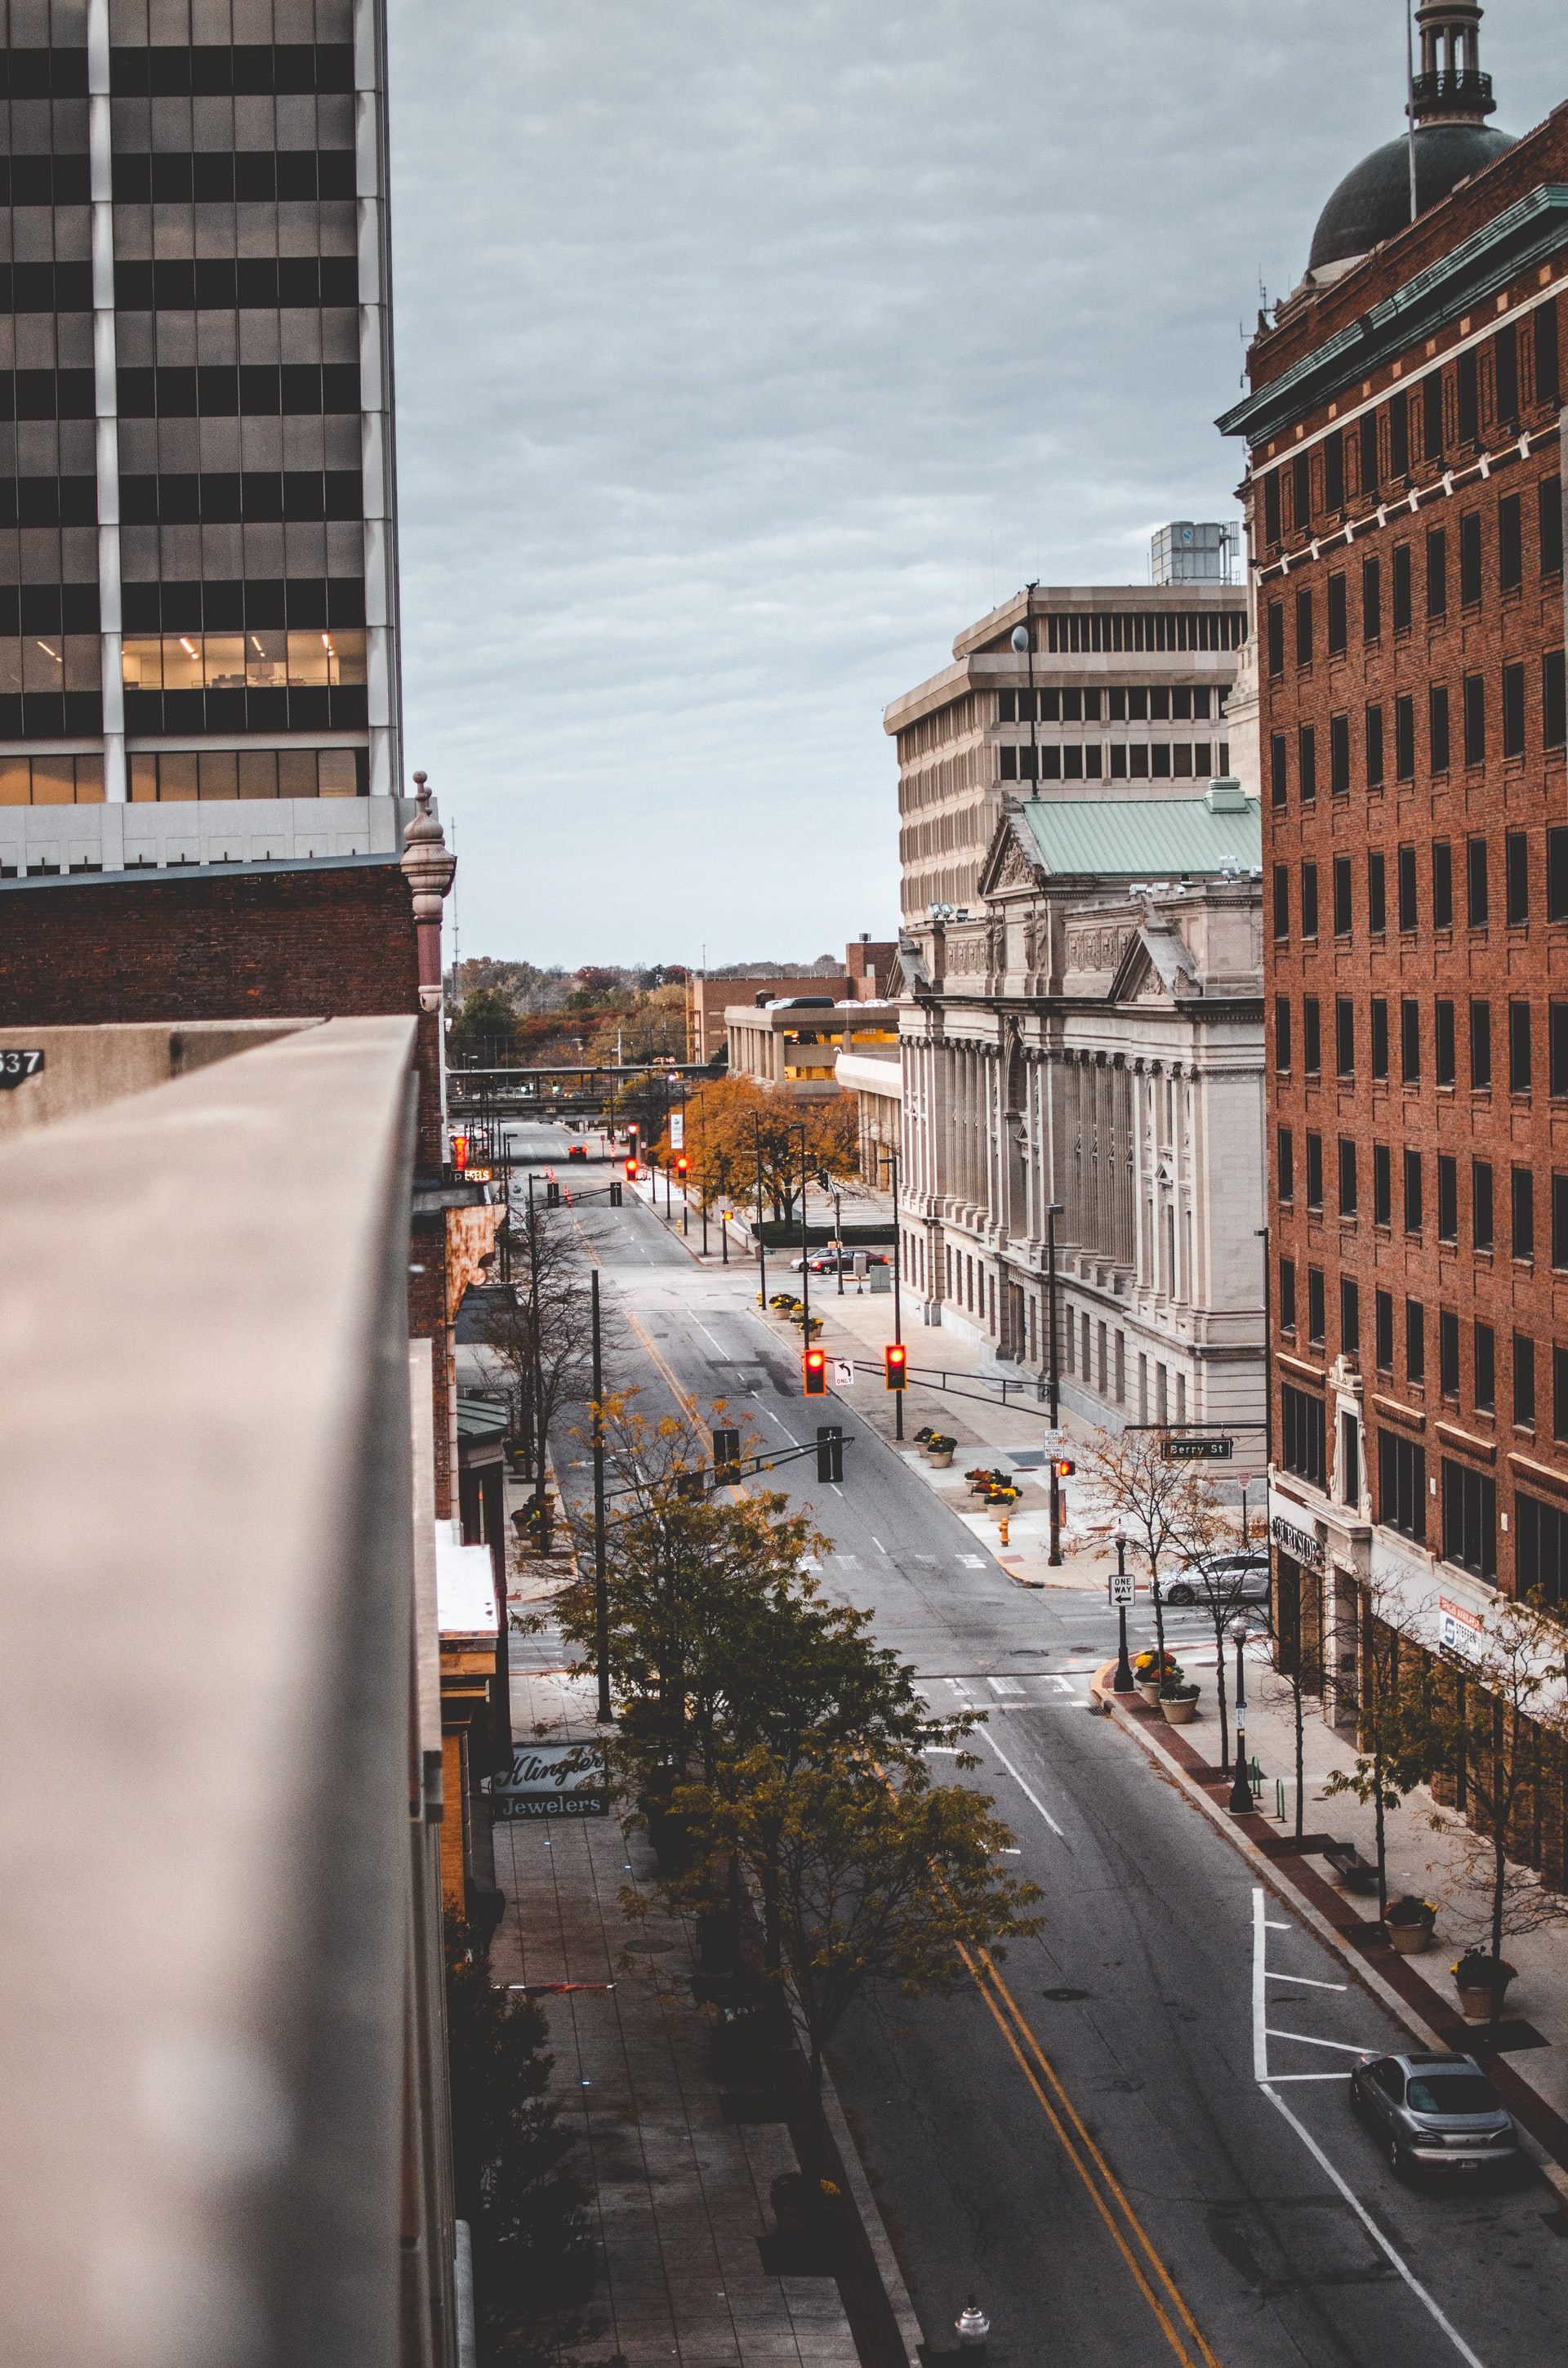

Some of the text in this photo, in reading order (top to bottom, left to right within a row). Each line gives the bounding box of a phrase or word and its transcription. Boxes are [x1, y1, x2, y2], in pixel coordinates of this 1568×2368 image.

[1169, 1444, 1223, 1455] Berry St
[502, 1795, 601, 1816] Jewelers
